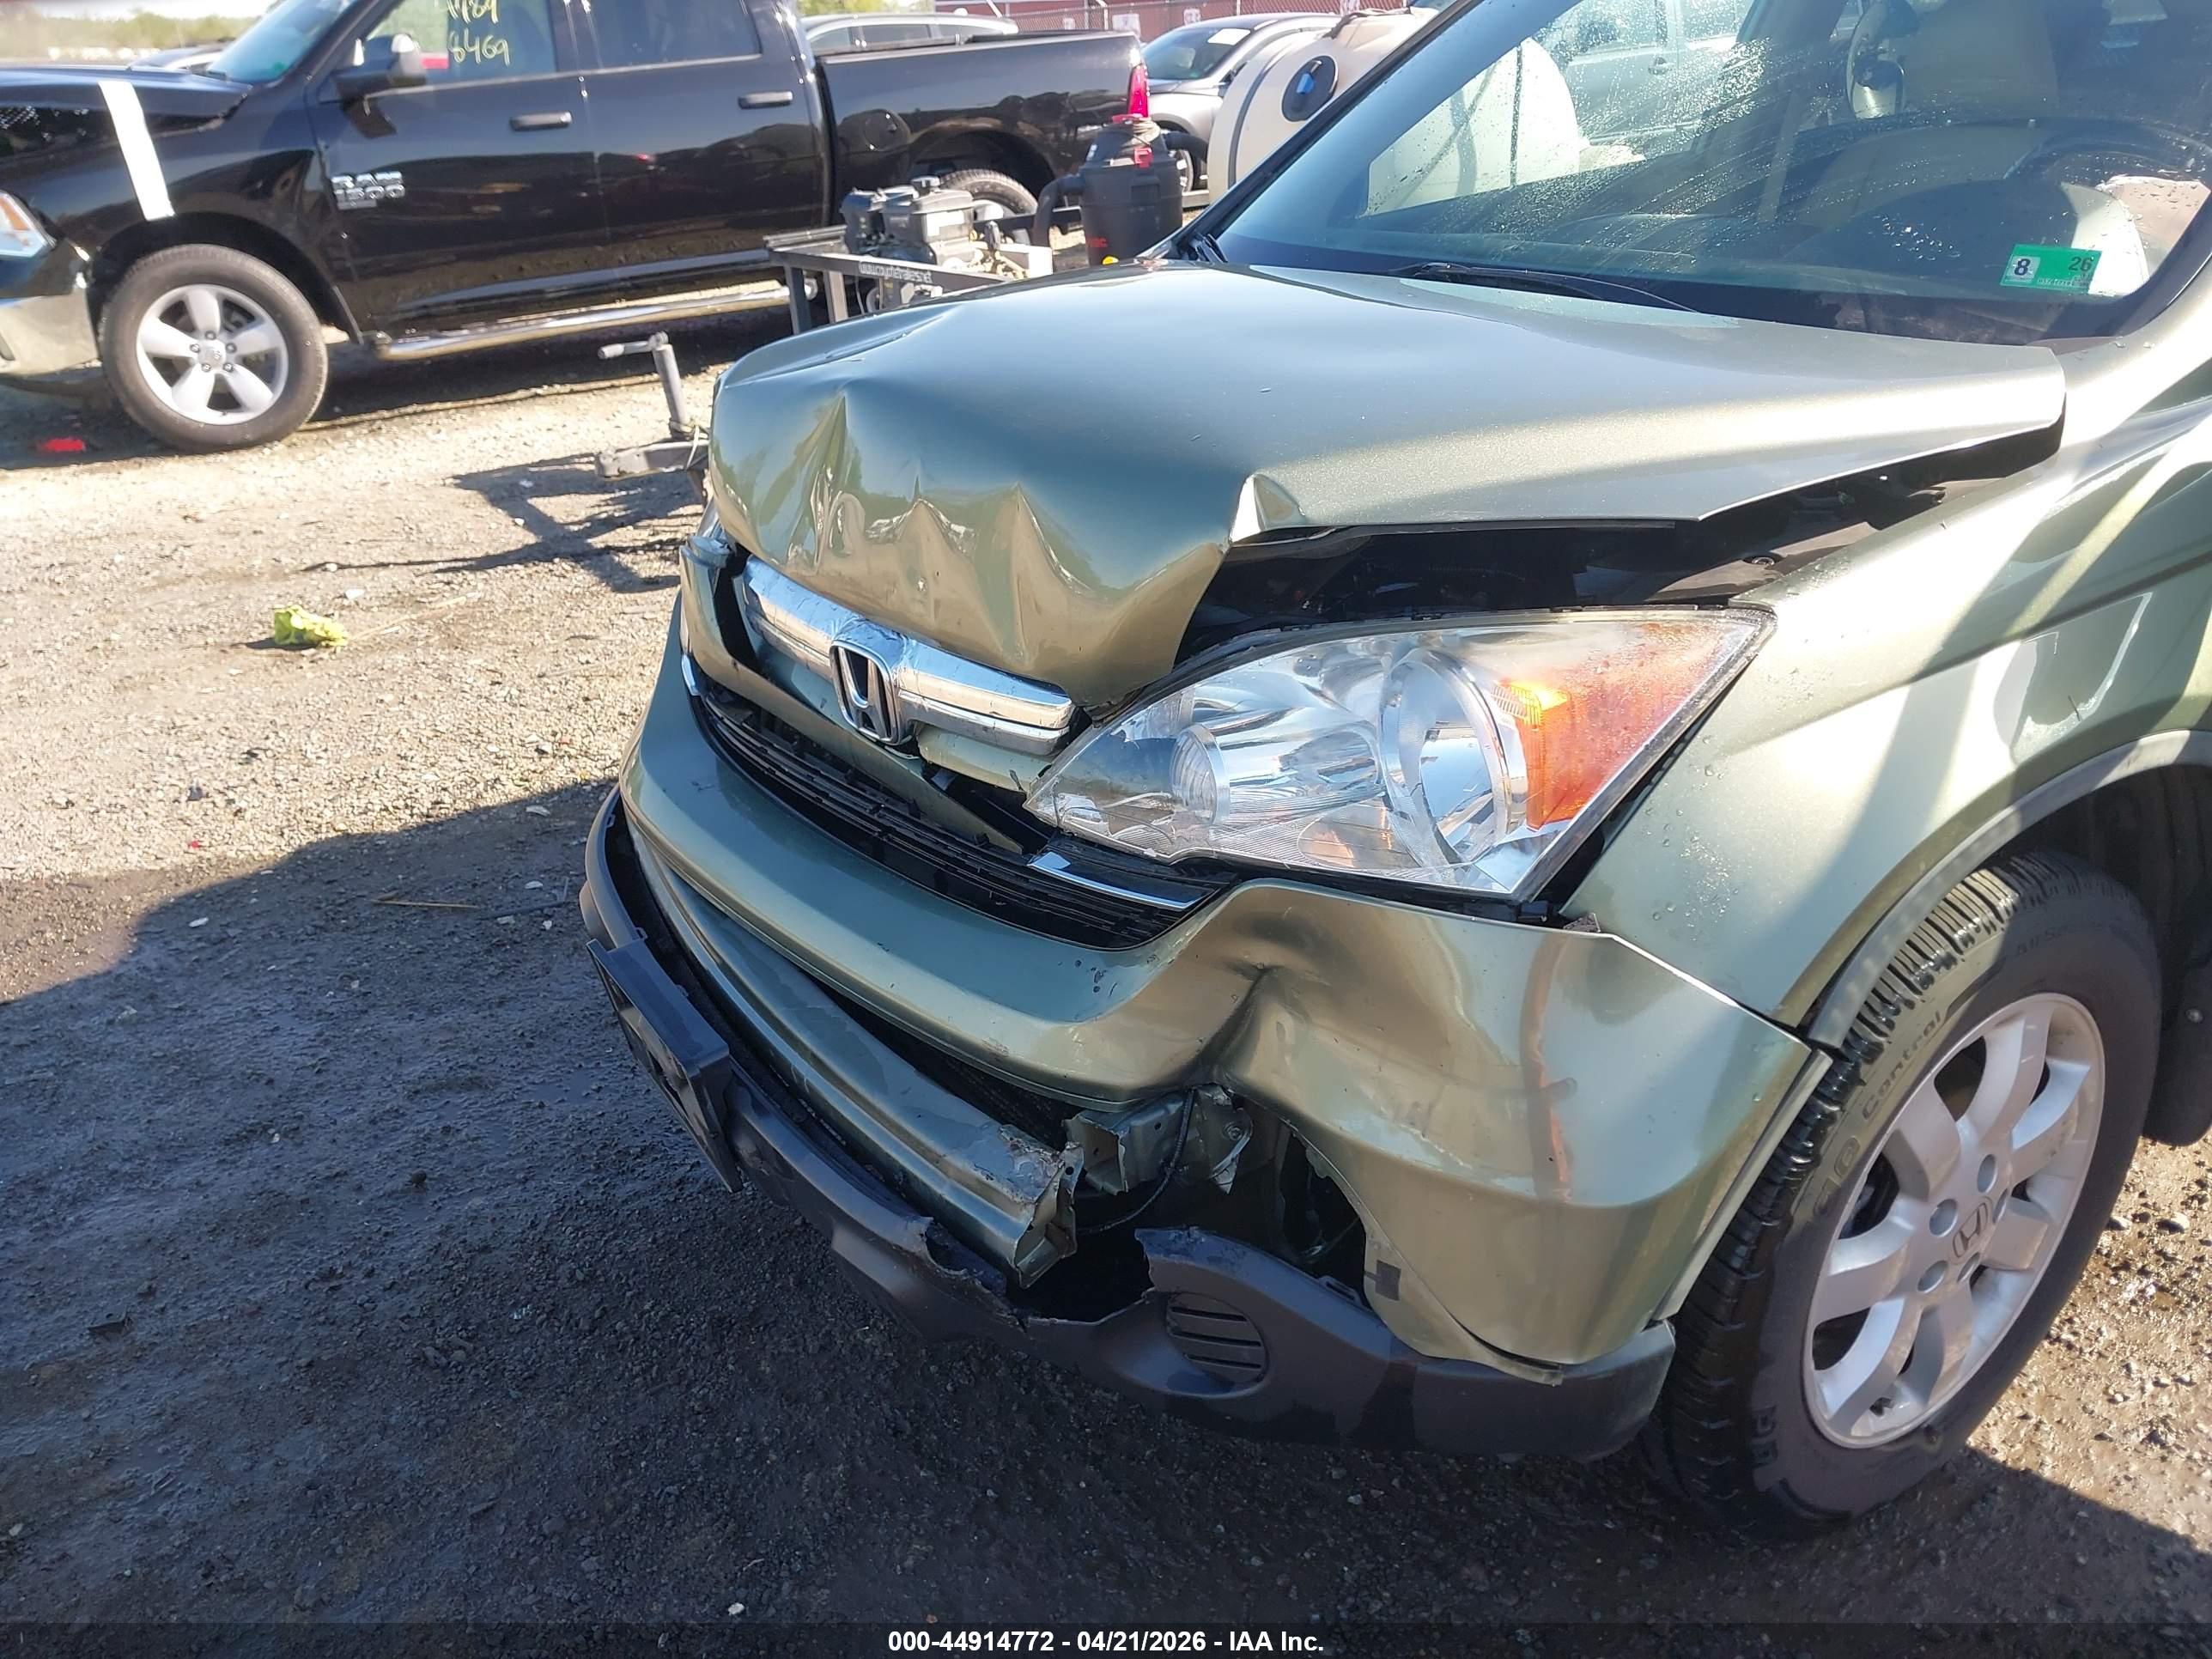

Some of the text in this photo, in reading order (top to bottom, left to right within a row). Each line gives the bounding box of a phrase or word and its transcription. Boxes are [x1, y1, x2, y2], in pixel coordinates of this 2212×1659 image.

[331, 171, 404, 189] RAM
[2014, 256, 2093, 276] 8 26
